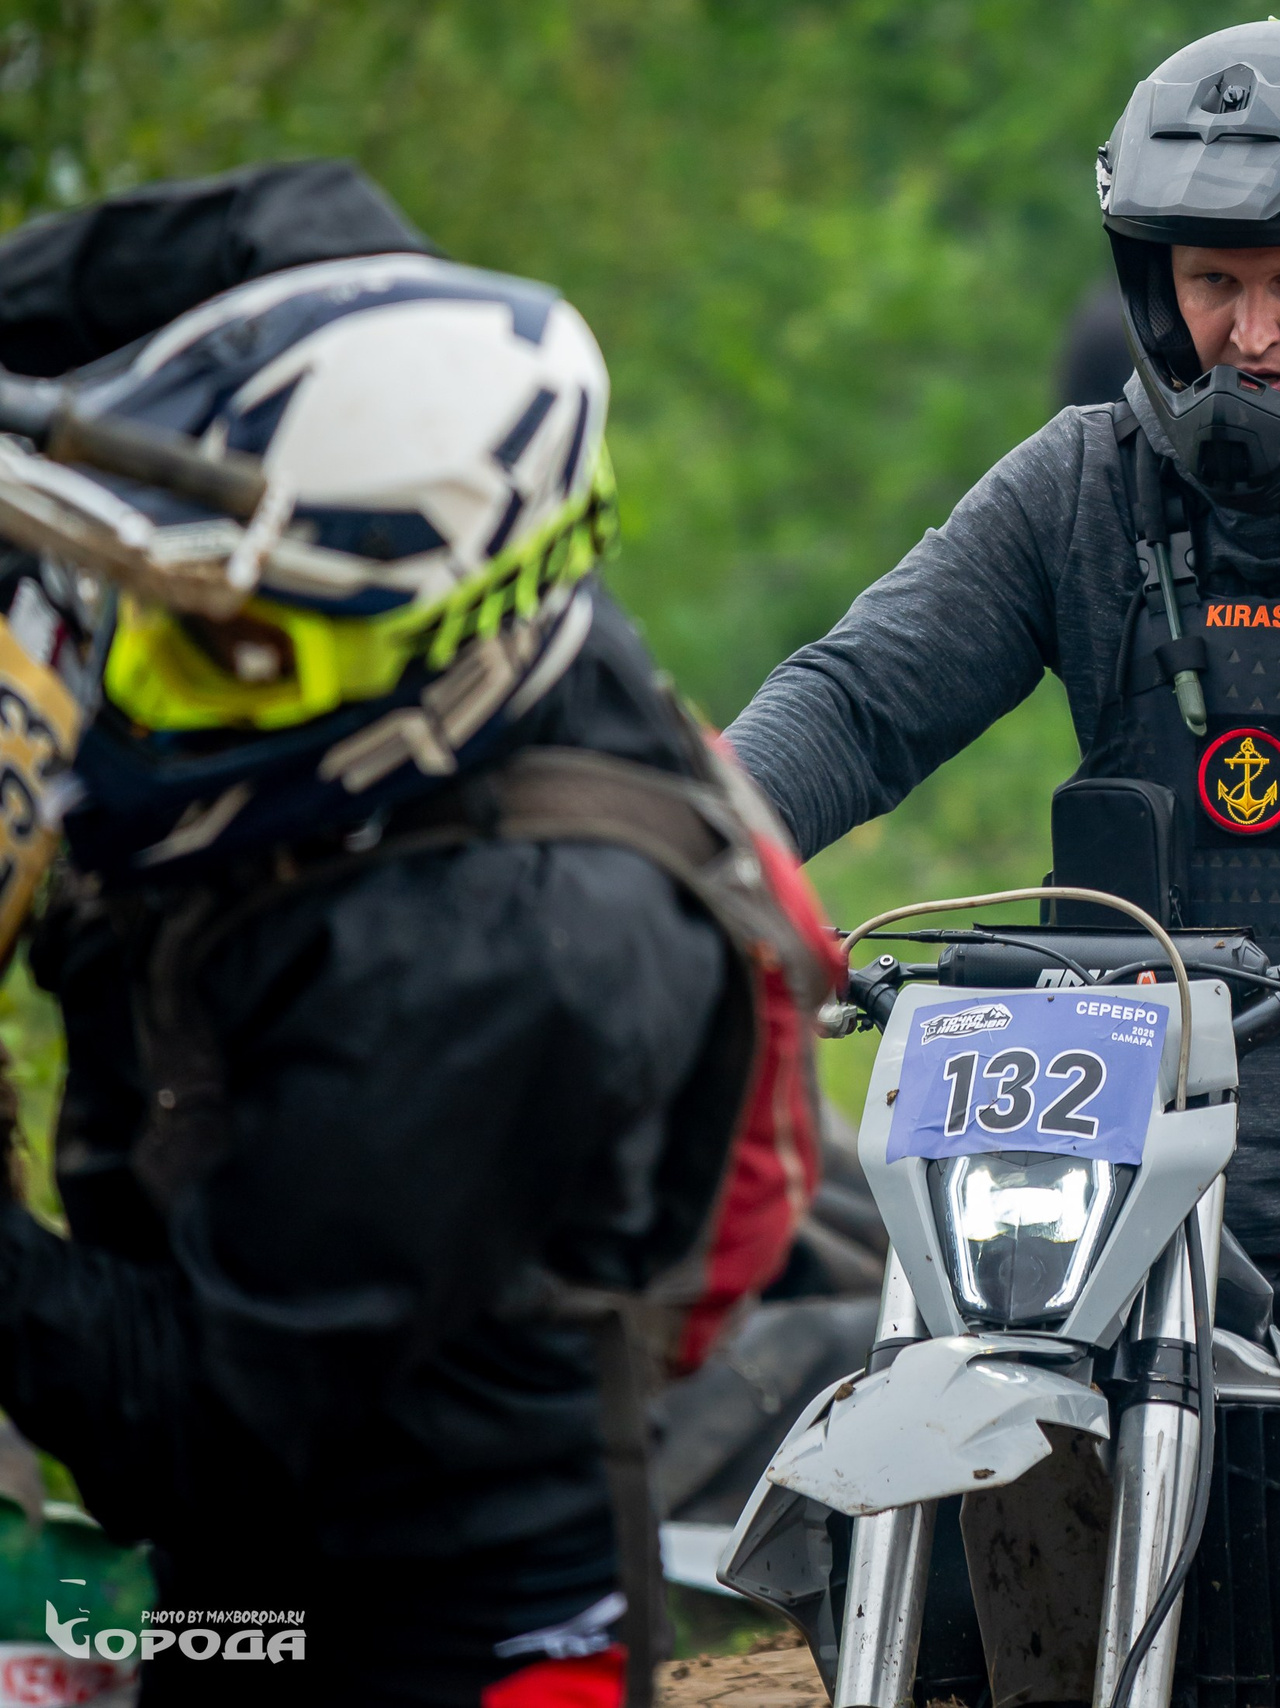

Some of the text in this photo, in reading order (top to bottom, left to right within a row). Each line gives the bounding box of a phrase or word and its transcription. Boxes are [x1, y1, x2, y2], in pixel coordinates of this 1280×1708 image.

[1076, 1001, 1158, 1025] СЕРЕБРО
[1111, 1032, 1153, 1047] САМАРА
[1132, 1026, 1155, 1038] 2025
[943, 1047, 1107, 1139] 132
